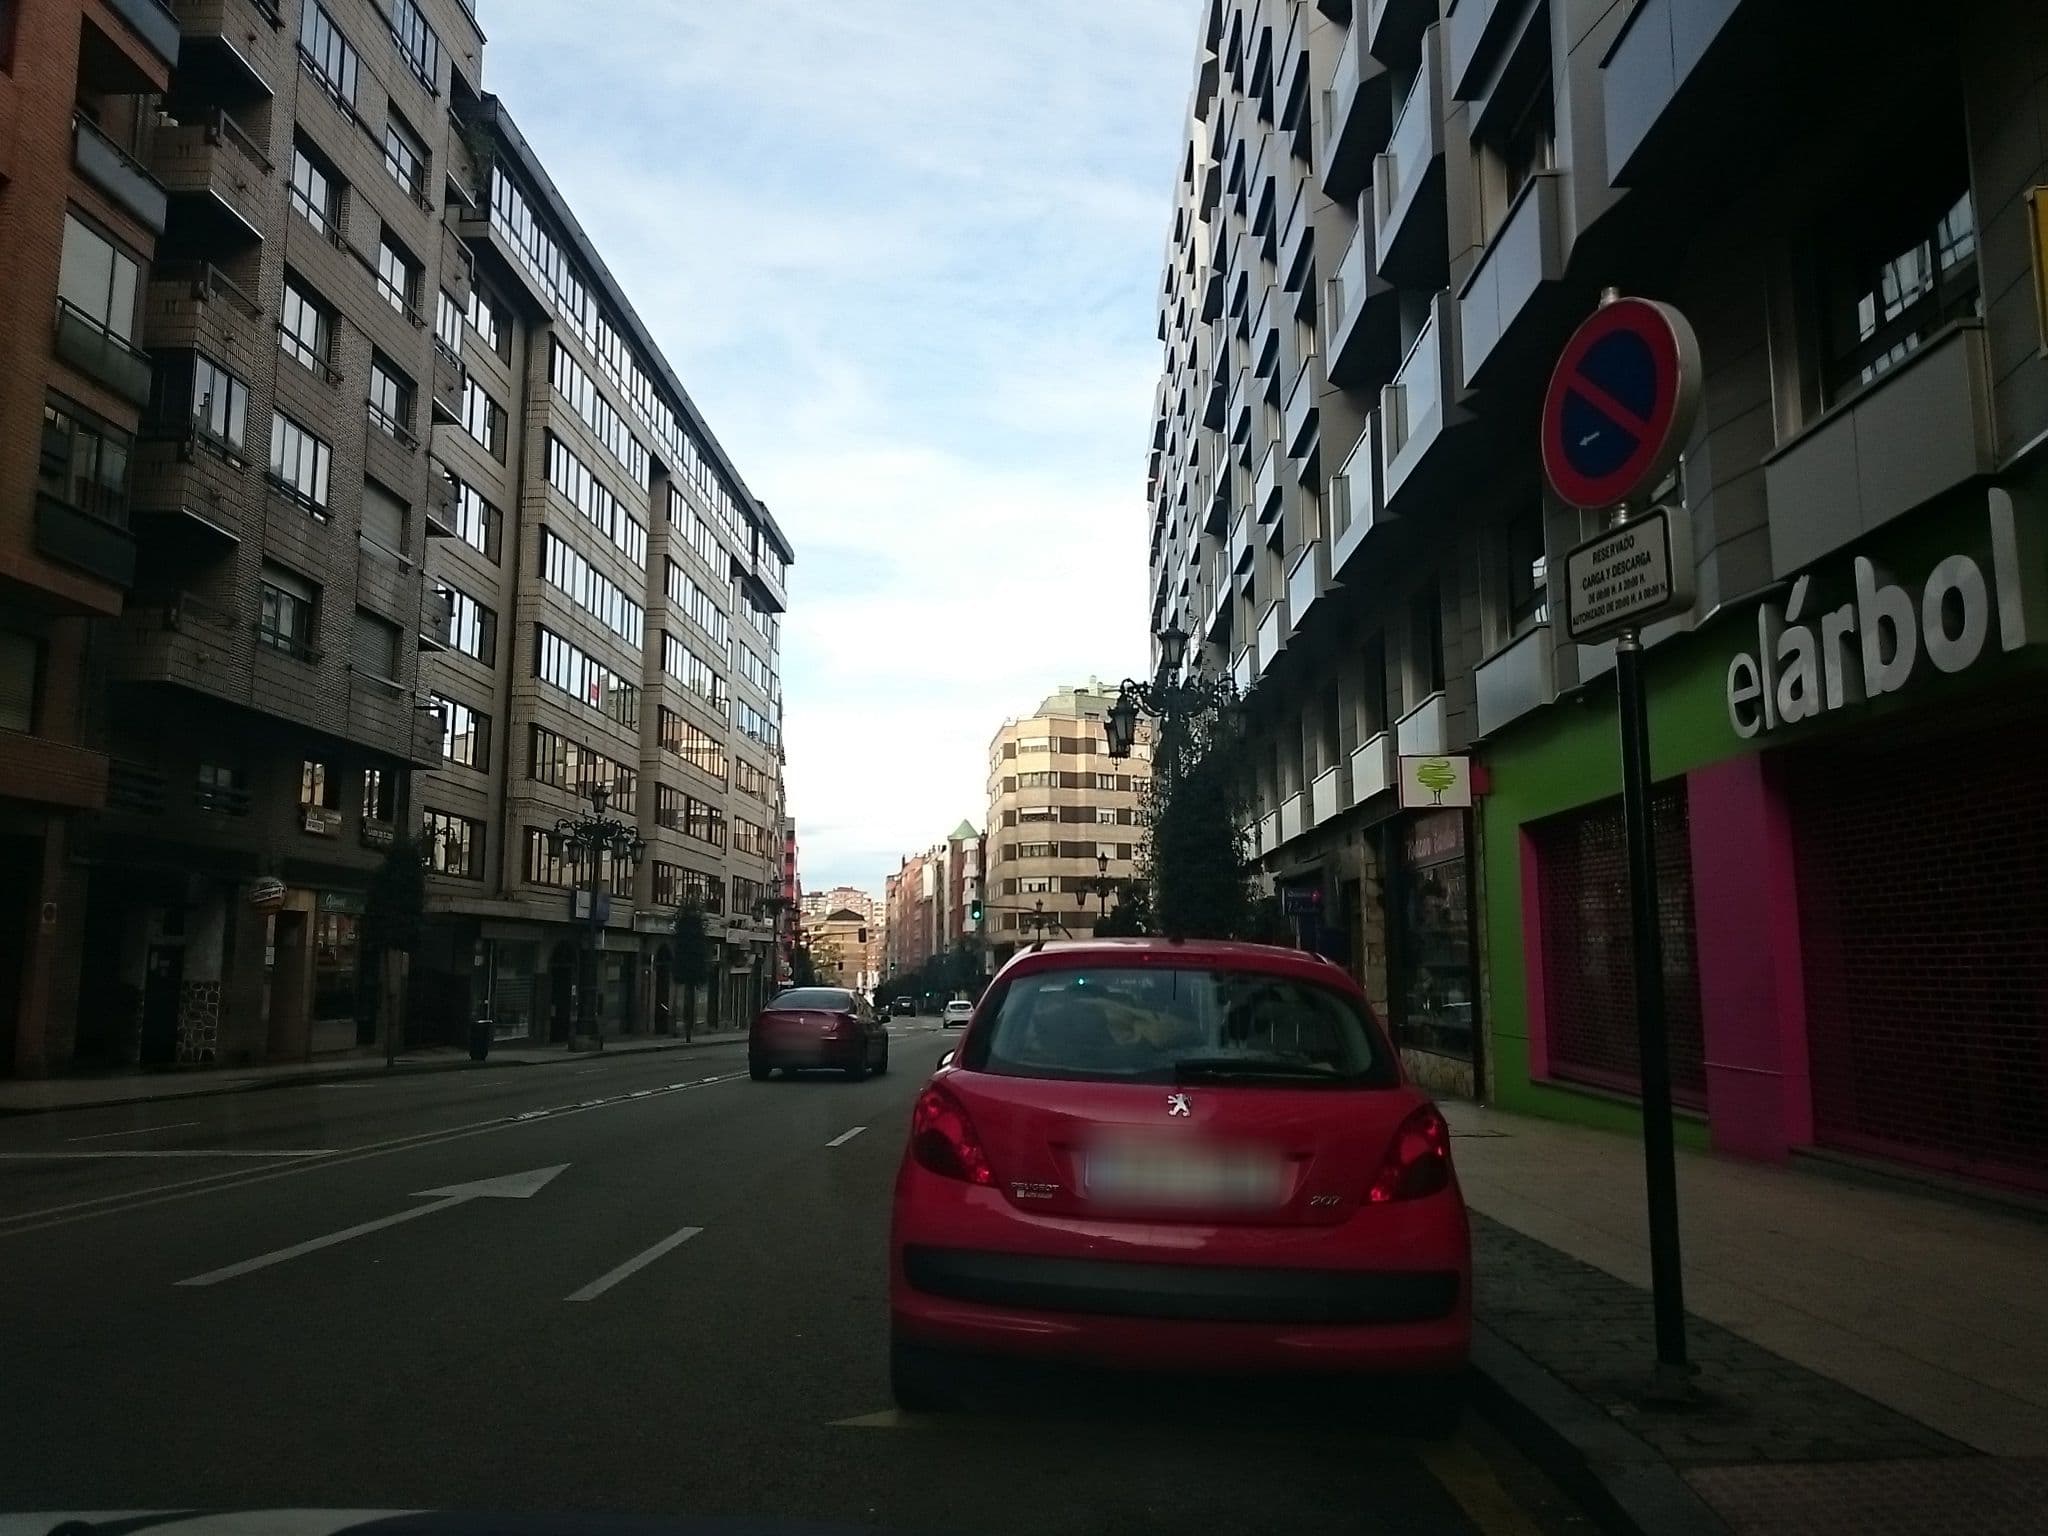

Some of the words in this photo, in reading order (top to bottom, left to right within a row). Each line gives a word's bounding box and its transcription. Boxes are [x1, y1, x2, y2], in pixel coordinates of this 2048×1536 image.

[1593, 535, 1634, 565] RESERVADO
[1582, 570, 1605, 590] CARGA
[1606, 567, 1611, 579] Y
[1612, 550, 1651, 577] DESCARGA
[1573, 604, 1605, 625] AUTORIZADO
[1011, 1182, 1059, 1191] PEUGEOT
[1310, 1195, 1342, 1205] 207
